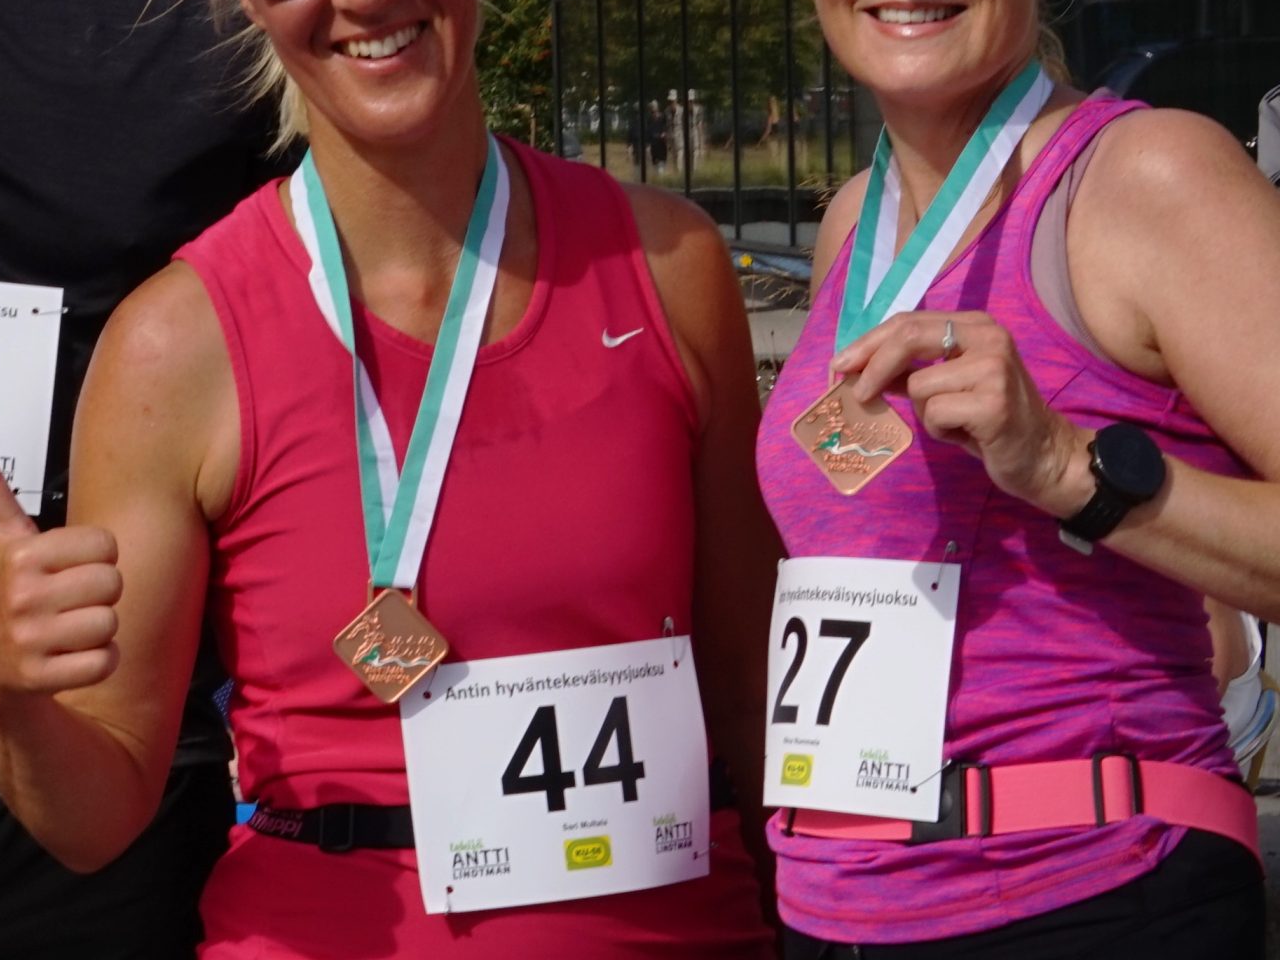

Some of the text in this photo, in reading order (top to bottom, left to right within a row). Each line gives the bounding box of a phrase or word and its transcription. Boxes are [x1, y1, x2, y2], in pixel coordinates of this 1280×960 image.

[445, 664, 665, 701] Antin hyväntekeväisyysjuoksu
[771, 616, 872, 726] 27
[501, 695, 646, 812] 44
[858, 760, 910, 780] ANTTI
[656, 821, 692, 842] ANTTI
[452, 847, 509, 868] ANTTI
